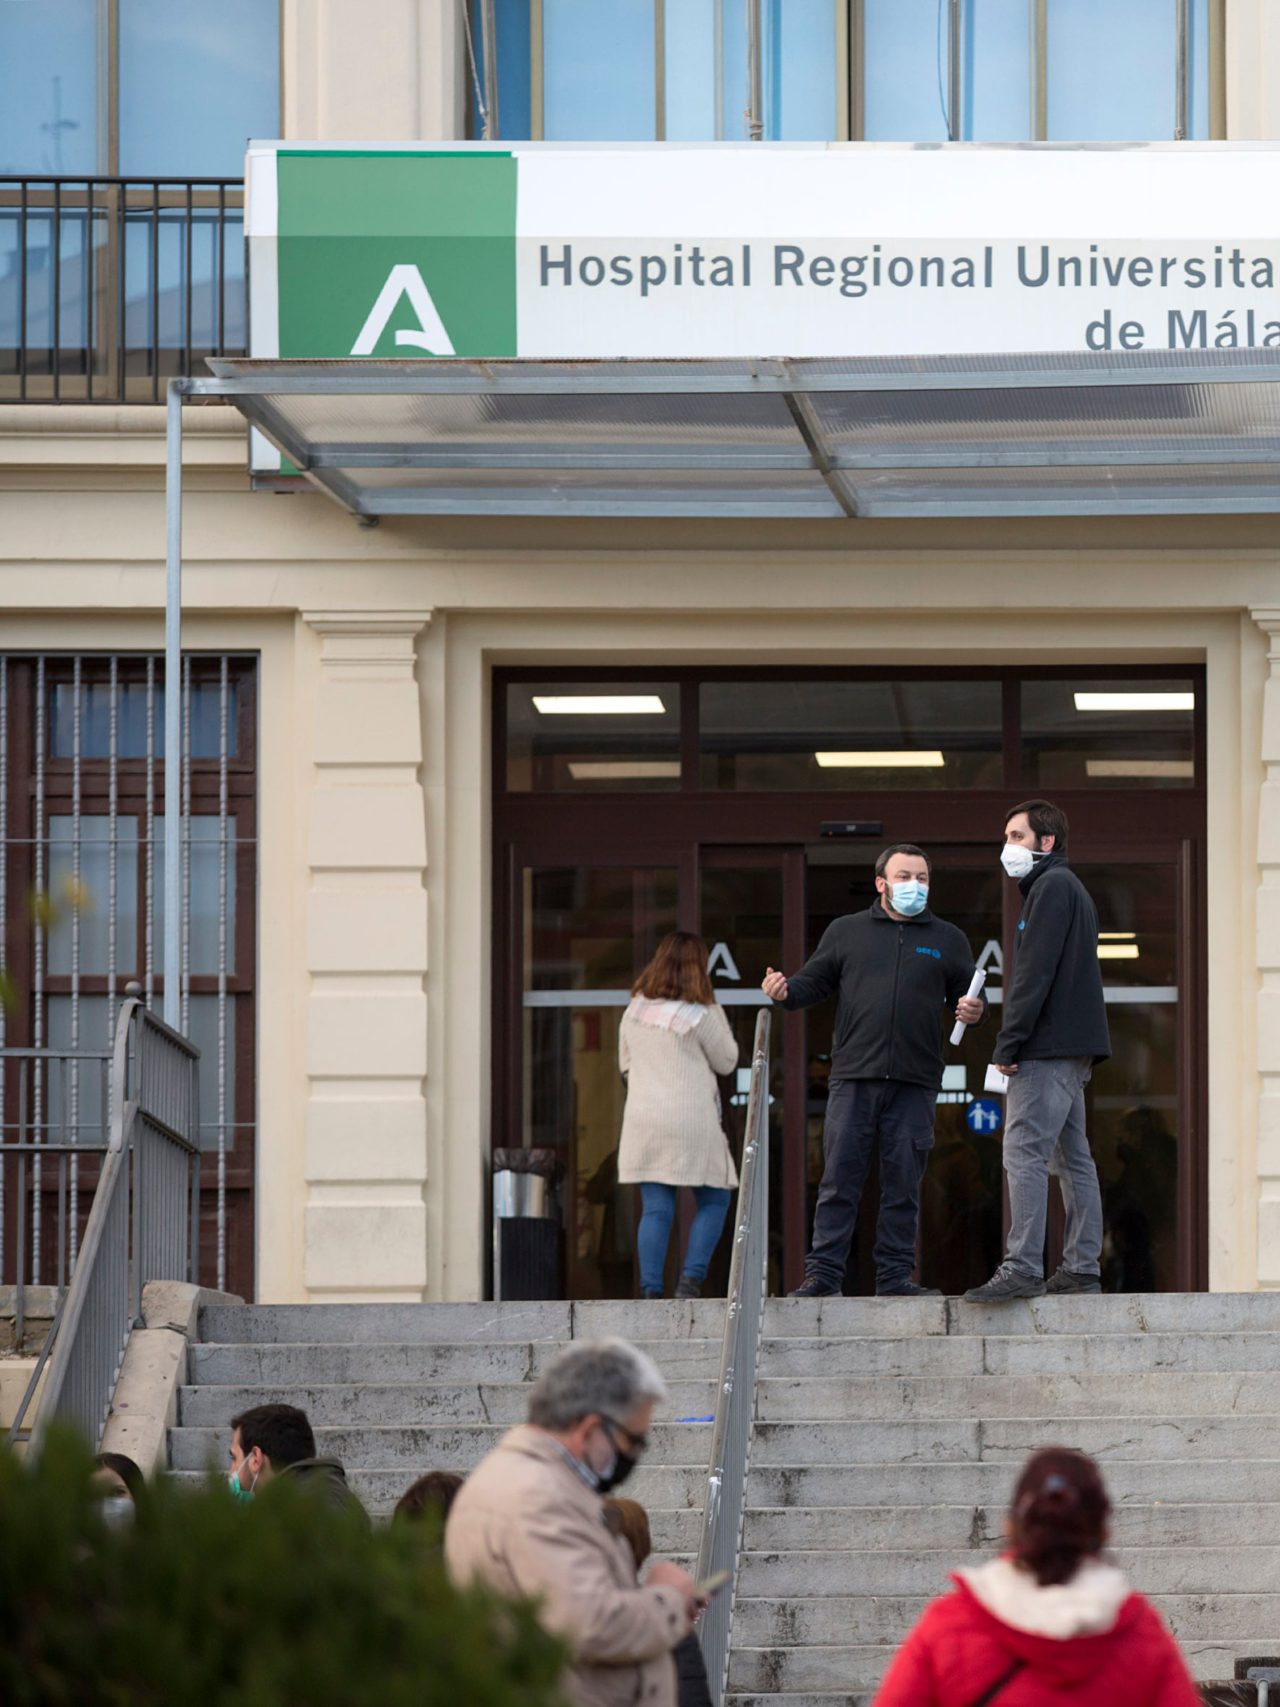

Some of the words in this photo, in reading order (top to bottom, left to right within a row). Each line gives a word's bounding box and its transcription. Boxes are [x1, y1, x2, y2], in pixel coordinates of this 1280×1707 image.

[540, 243, 751, 297] Hospital
[773, 243, 993, 298] Regional
[1085, 309, 1146, 351] de
